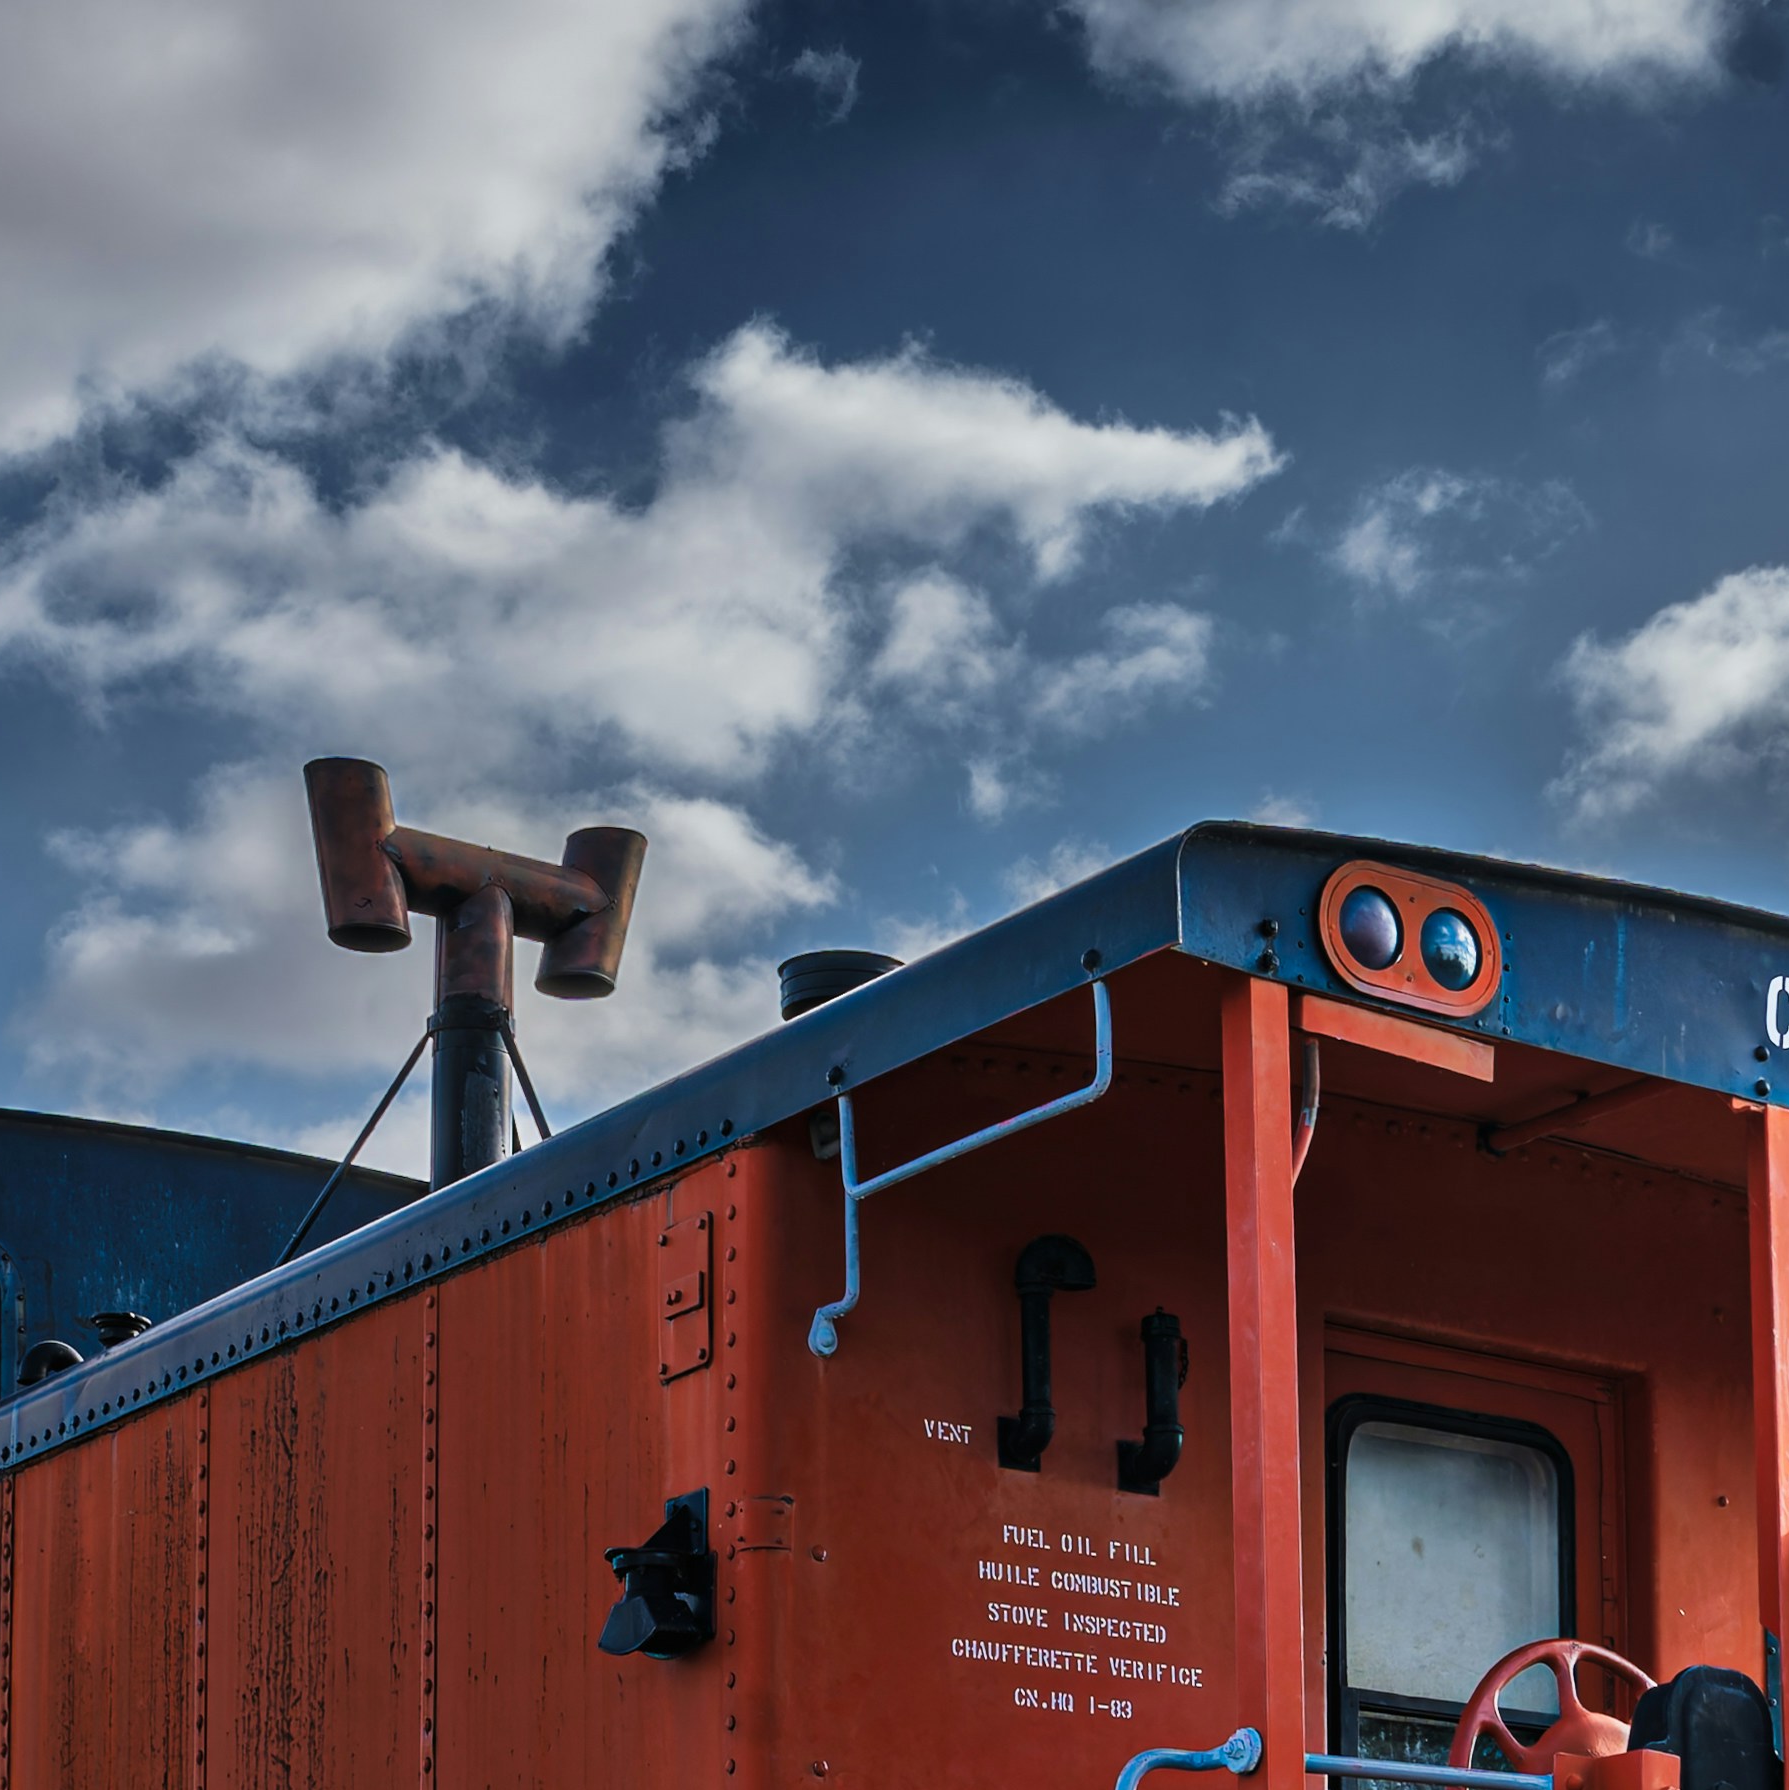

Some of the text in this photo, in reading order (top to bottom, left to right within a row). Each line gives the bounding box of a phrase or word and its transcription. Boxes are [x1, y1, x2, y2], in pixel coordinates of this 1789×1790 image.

[924, 1418, 972, 1445] VENT
[1002, 1524, 1157, 1566] FUEL OIL FILL
[978, 1560, 1180, 1607] HUILE COMBUSTIBLE
[987, 1602, 1167, 1644] STOVE INSPECTED
[951, 1638, 1203, 1688] CHAUFFERETTE VERIFICE
[1089, 1696, 1133, 1719] 1-83
